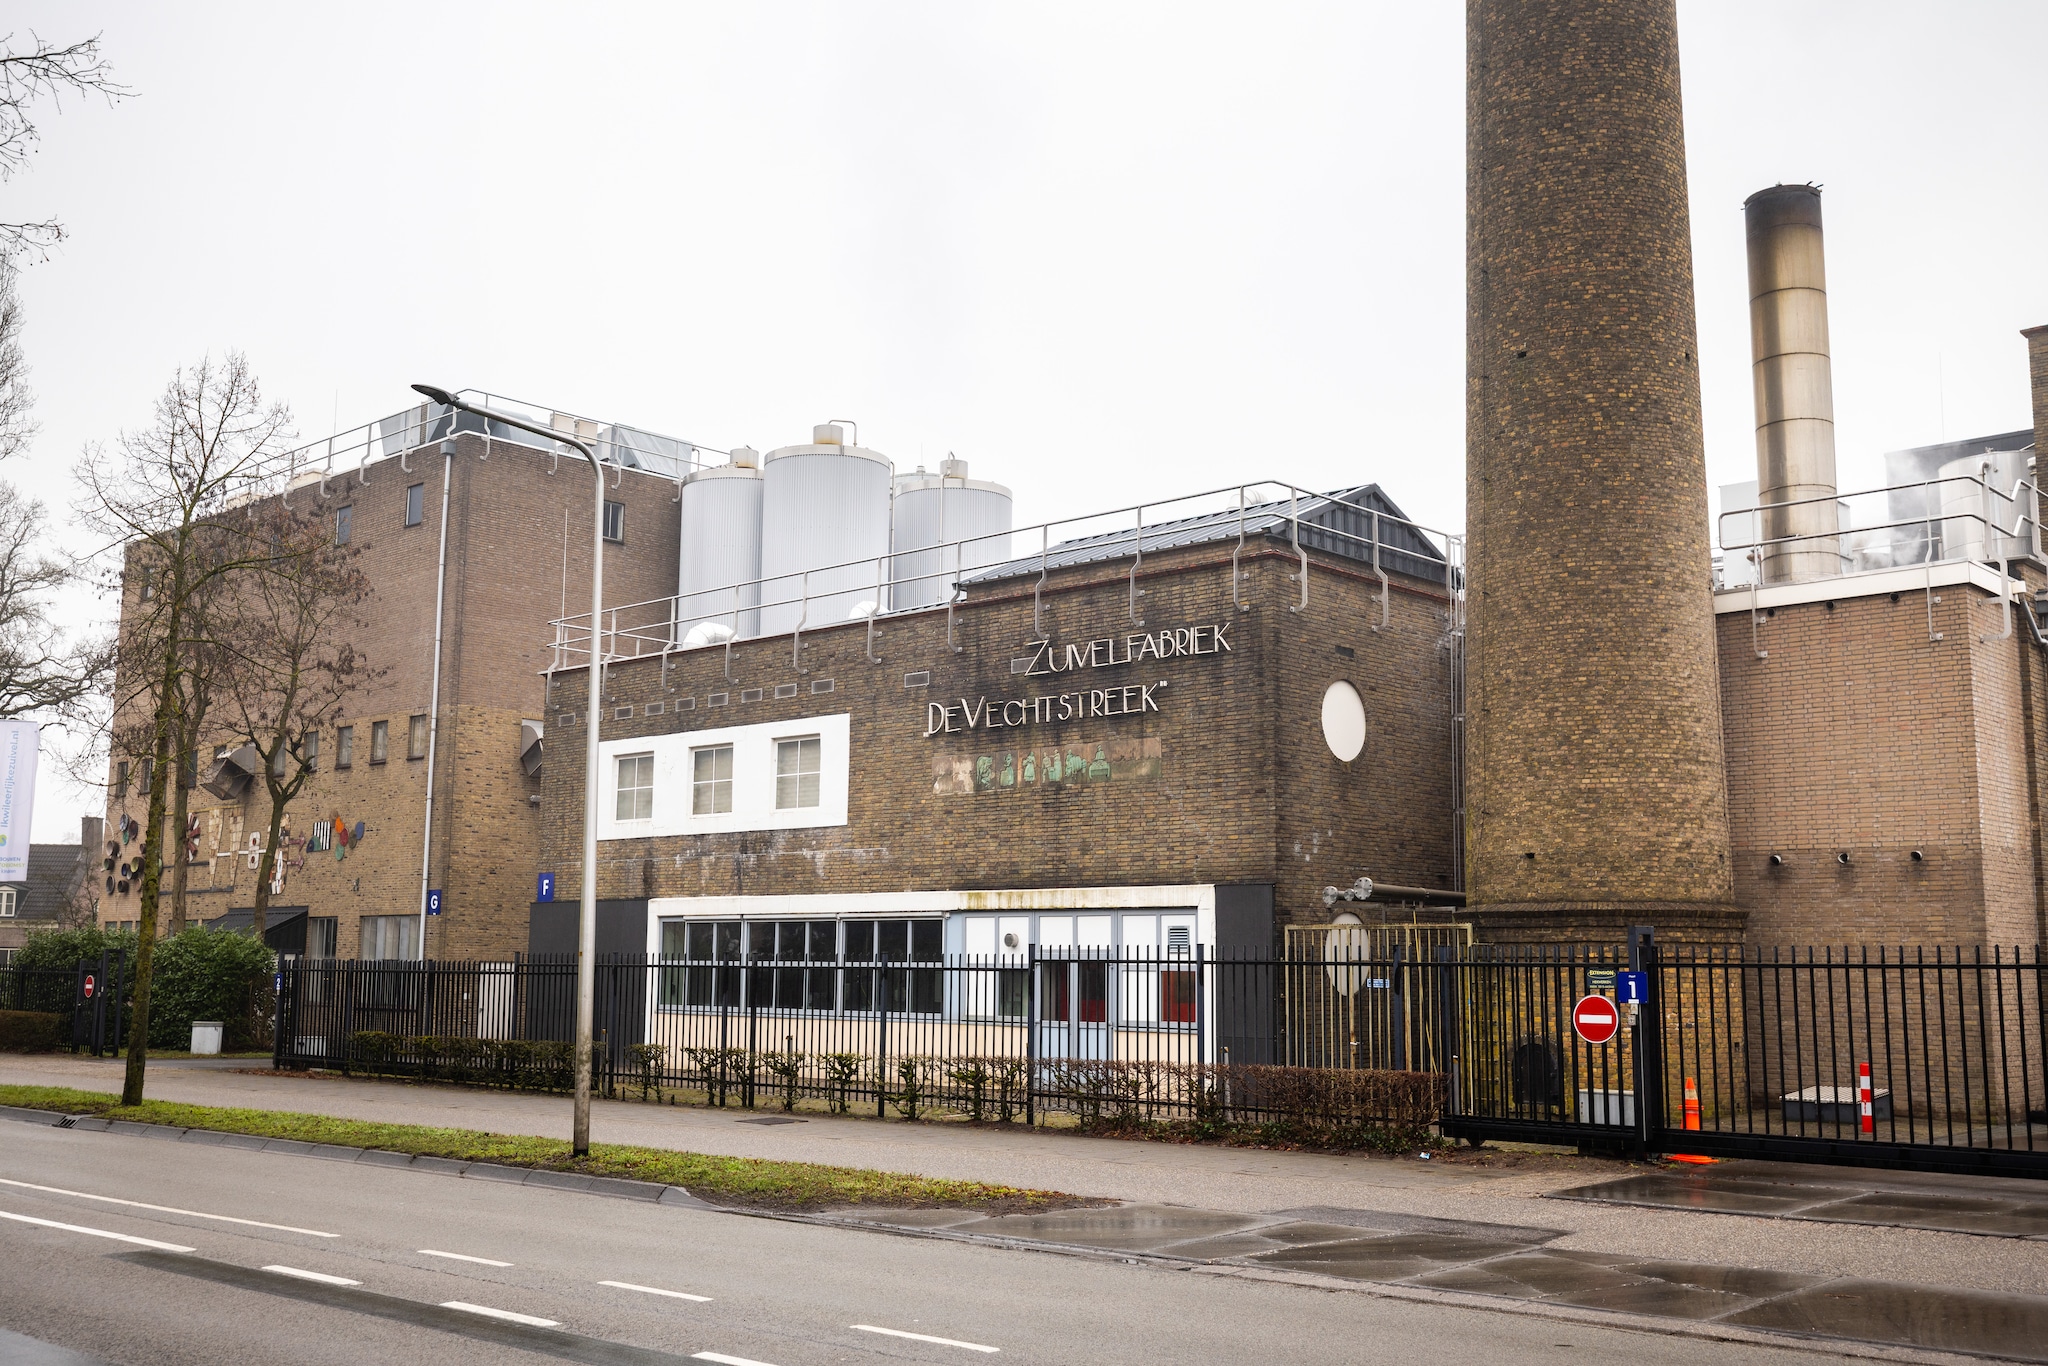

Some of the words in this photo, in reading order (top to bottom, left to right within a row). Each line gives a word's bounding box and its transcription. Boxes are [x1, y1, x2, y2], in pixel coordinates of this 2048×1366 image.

[542, 879, 550, 896] F
[430, 894, 439, 910] G
[1628, 981, 1636, 998] 1
